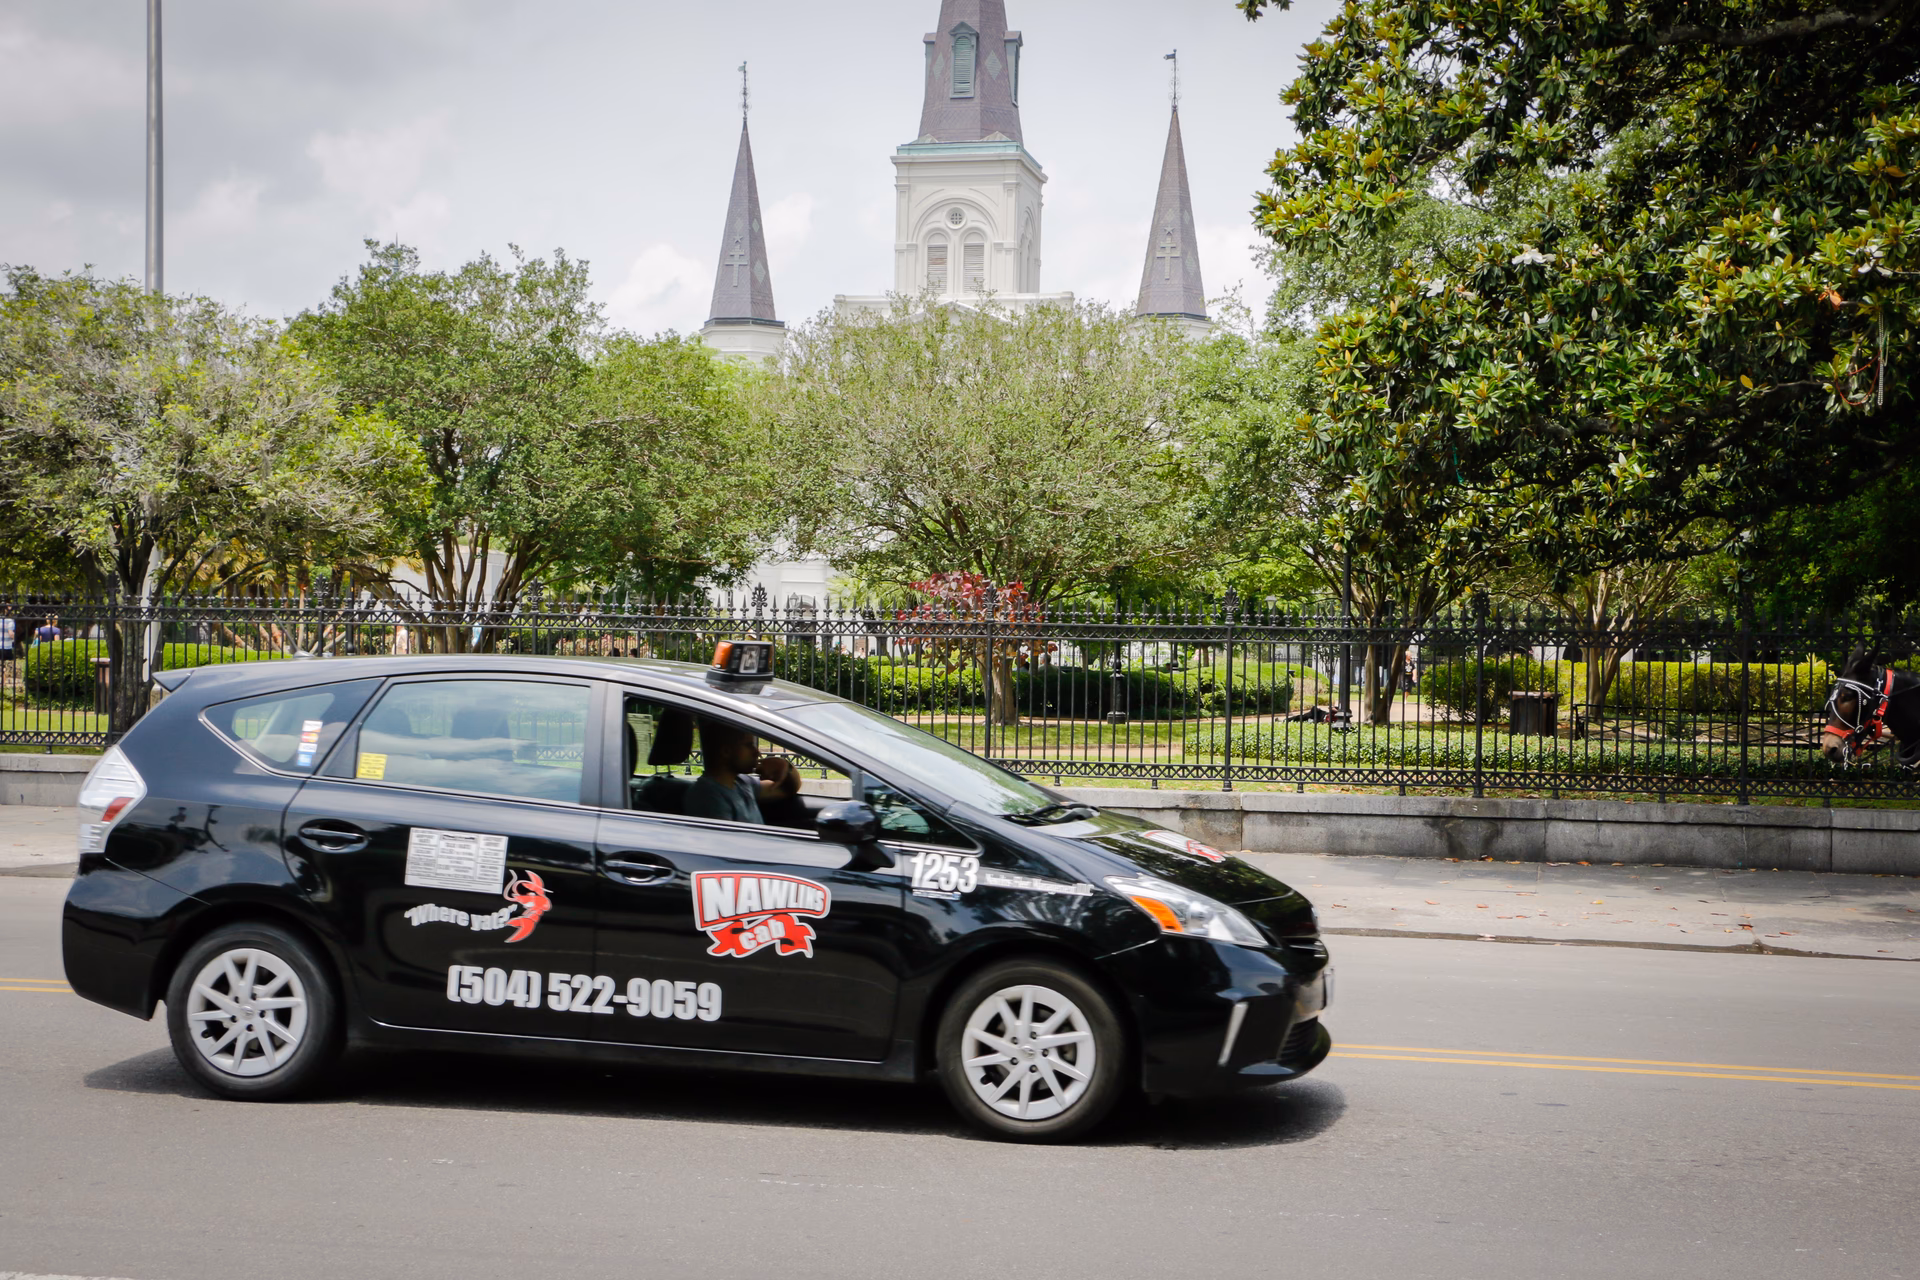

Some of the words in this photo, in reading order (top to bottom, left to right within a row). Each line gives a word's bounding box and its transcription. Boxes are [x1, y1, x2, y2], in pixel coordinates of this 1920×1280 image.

[910, 852, 980, 893] 1253
[701, 877, 825, 922] NAWLINS
[739, 919, 786, 950] cab
[446, 964, 542, 1008] (504)
[548, 972, 722, 1021] 522-9059
